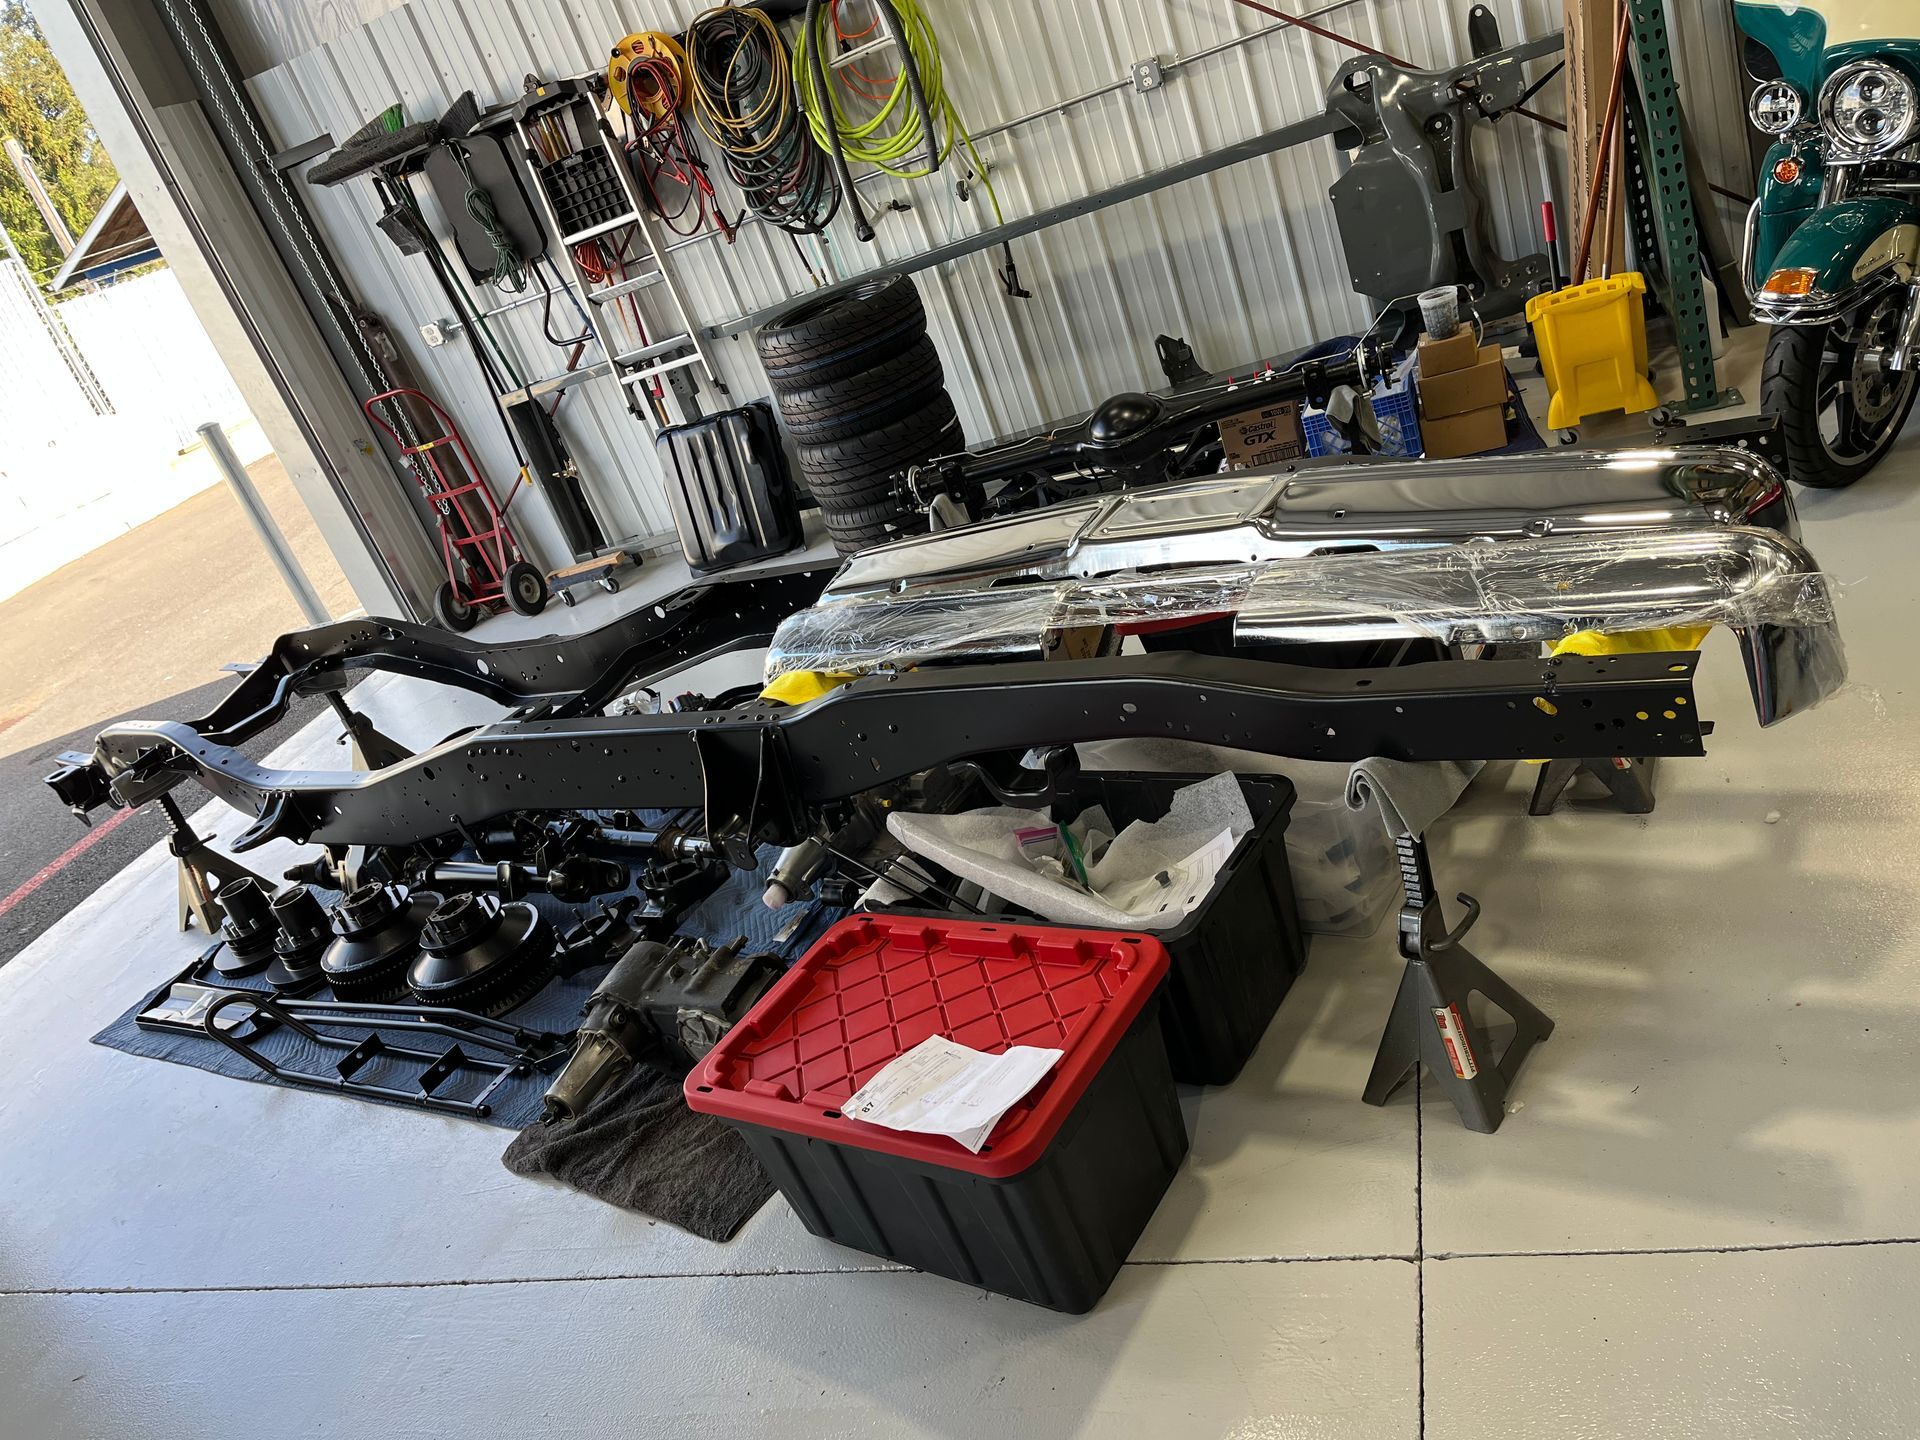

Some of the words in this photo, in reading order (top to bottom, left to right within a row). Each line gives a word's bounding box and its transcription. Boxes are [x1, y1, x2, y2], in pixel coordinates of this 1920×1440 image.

[1248, 421, 1273, 433] Castrol
[1244, 430, 1276, 446] GTX
[1457, 1030, 1475, 1072] PITTSBURGH
[861, 1101, 874, 1113] 87
